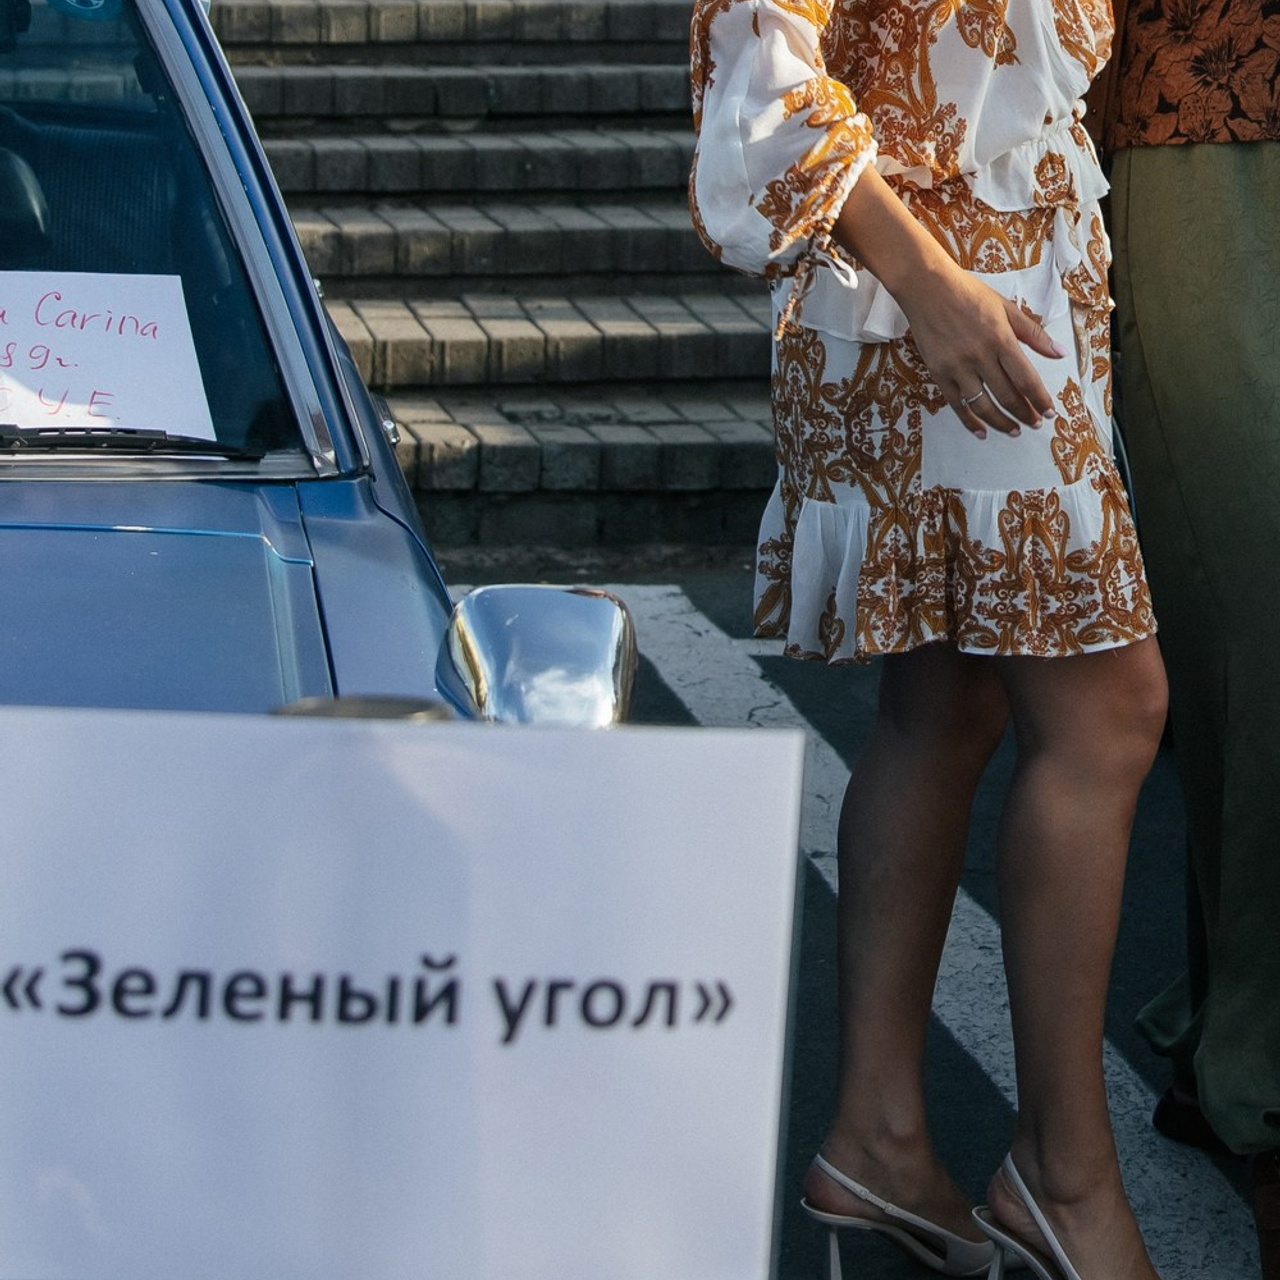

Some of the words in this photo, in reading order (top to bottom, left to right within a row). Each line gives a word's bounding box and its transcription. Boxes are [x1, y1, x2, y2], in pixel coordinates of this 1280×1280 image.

[34, 291, 158, 339] Carina
[1, 949, 463, 1026] «Зеленый
[493, 977, 736, 1045] угол»
